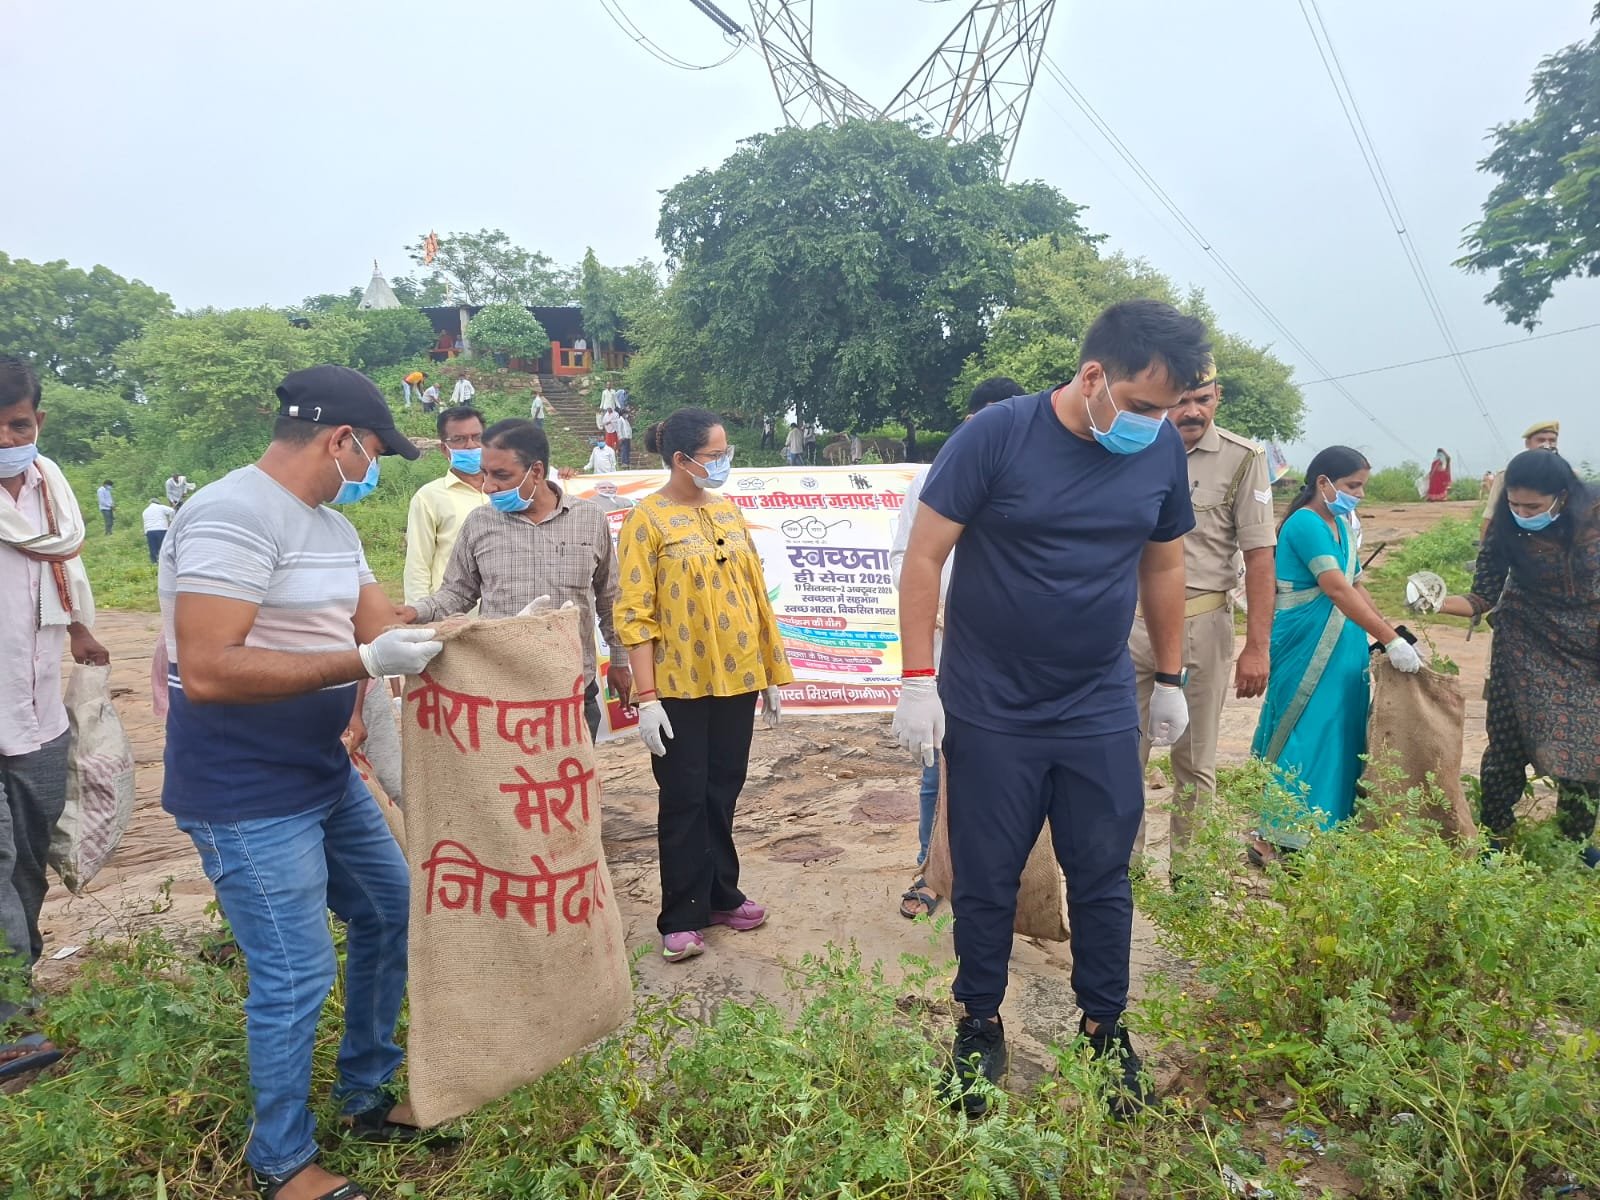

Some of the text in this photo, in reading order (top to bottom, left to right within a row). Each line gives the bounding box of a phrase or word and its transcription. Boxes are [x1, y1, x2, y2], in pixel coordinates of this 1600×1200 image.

[759, 492, 827, 509] अभियान
[786, 546, 889, 570] स्वच्छता
[792, 569, 891, 585] ही सेवा 2026
[801, 595, 835, 603] स्वच्छता
[784, 605, 809, 614] स्वच्छ
[838, 604, 874, 616] विकसित
[875, 607, 896, 616] भारत
[407, 671, 494, 755] मेरा
[500, 757, 595, 834] मेरी
